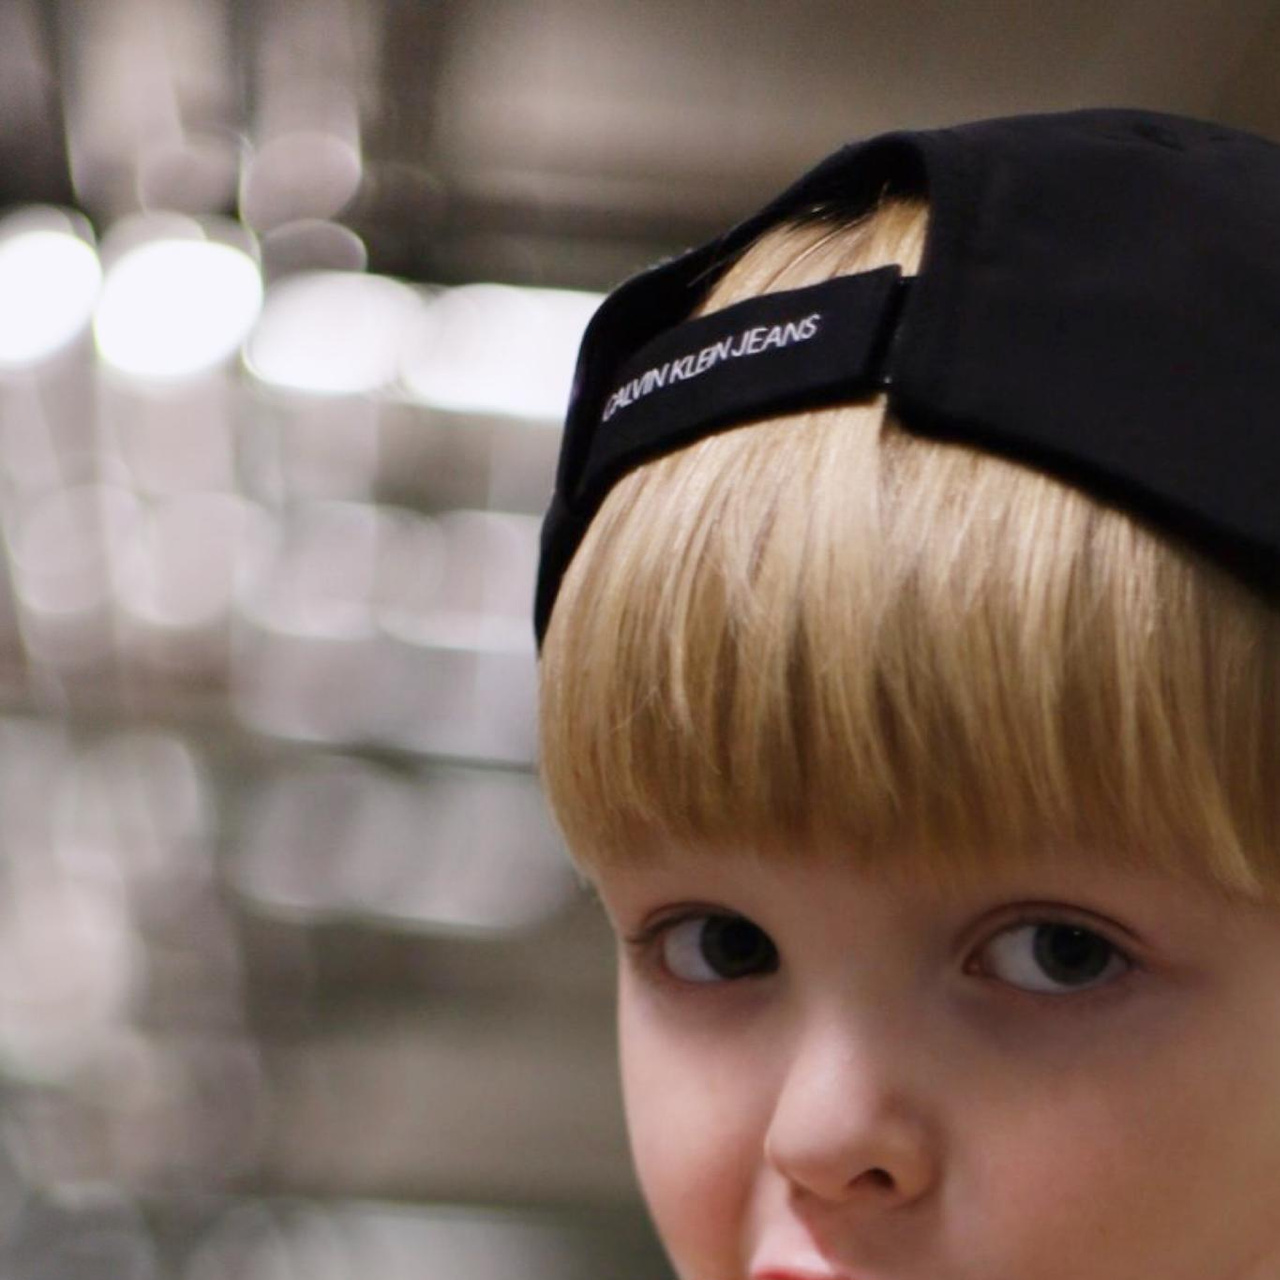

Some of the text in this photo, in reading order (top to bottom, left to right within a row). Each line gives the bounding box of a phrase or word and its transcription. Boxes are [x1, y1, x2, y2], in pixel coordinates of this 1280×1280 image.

[602, 313, 822, 422] CALVIN KLEIN JEANS
